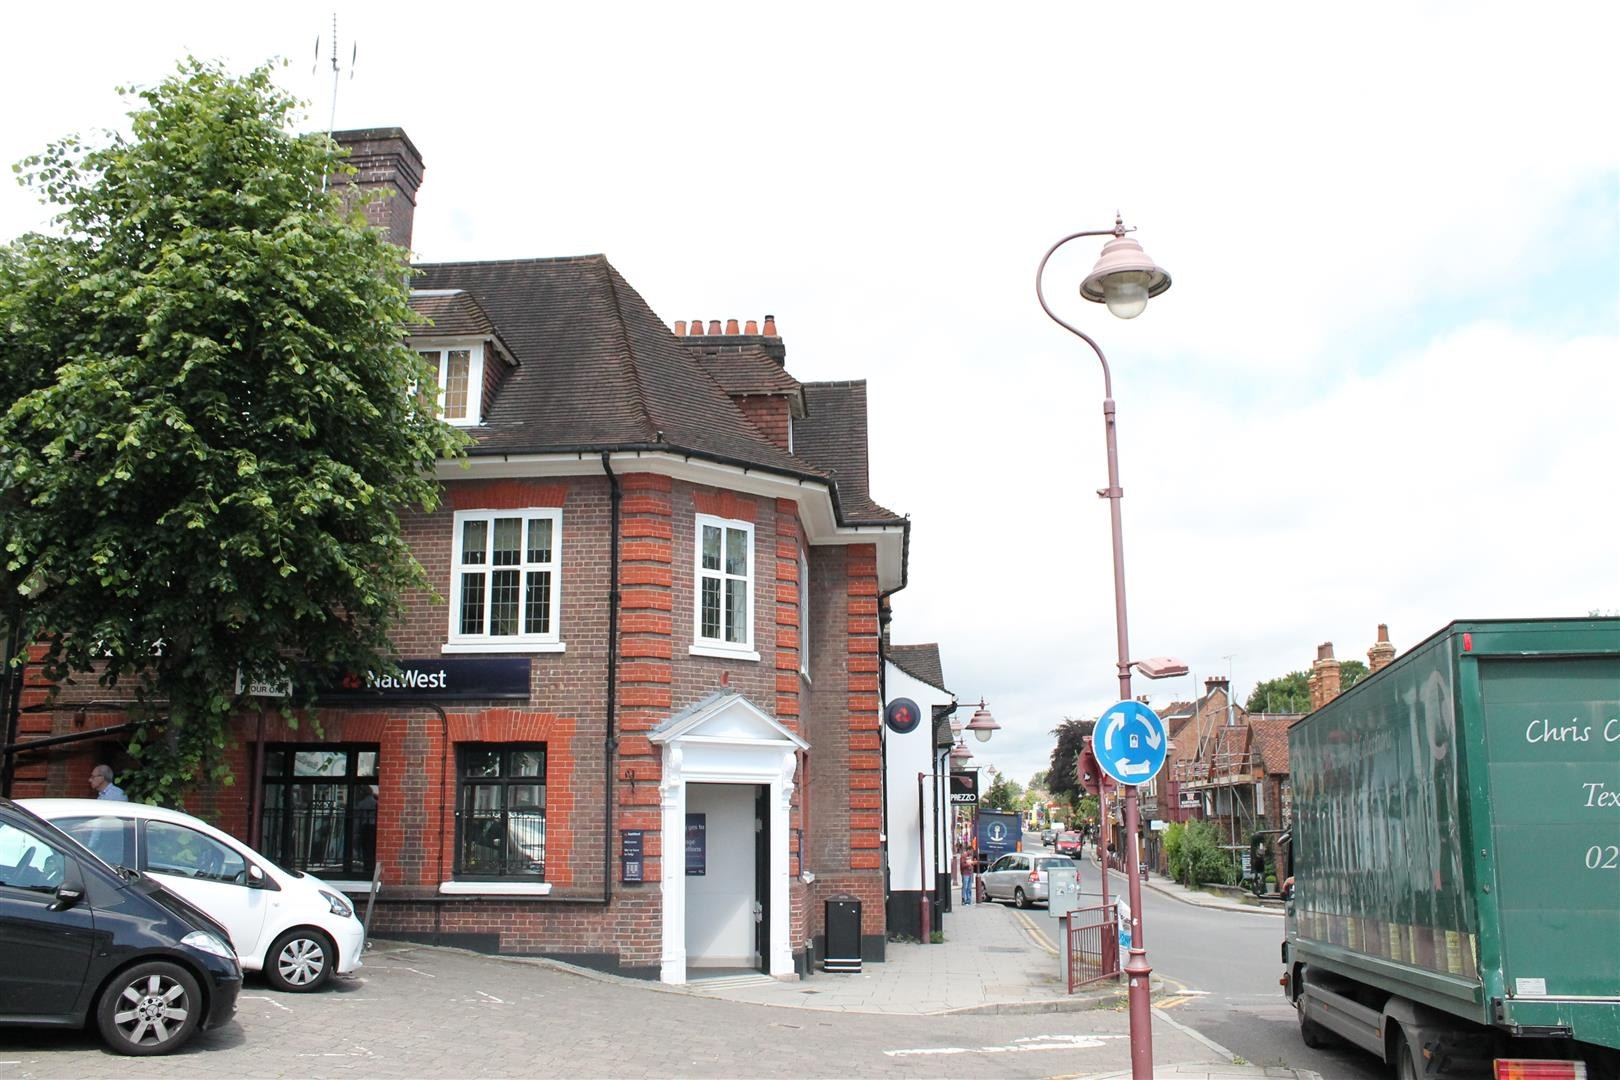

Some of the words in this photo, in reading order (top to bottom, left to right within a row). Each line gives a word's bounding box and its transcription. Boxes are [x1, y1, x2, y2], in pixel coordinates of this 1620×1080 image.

[249, 685, 268, 693] OUR
[366, 669, 447, 689] NatWest
[1526, 717, 1592, 743] Chris
[951, 793, 976, 801] PREZZO
[1582, 782, 1620, 807] Tex
[1585, 845, 1619, 869] 02
